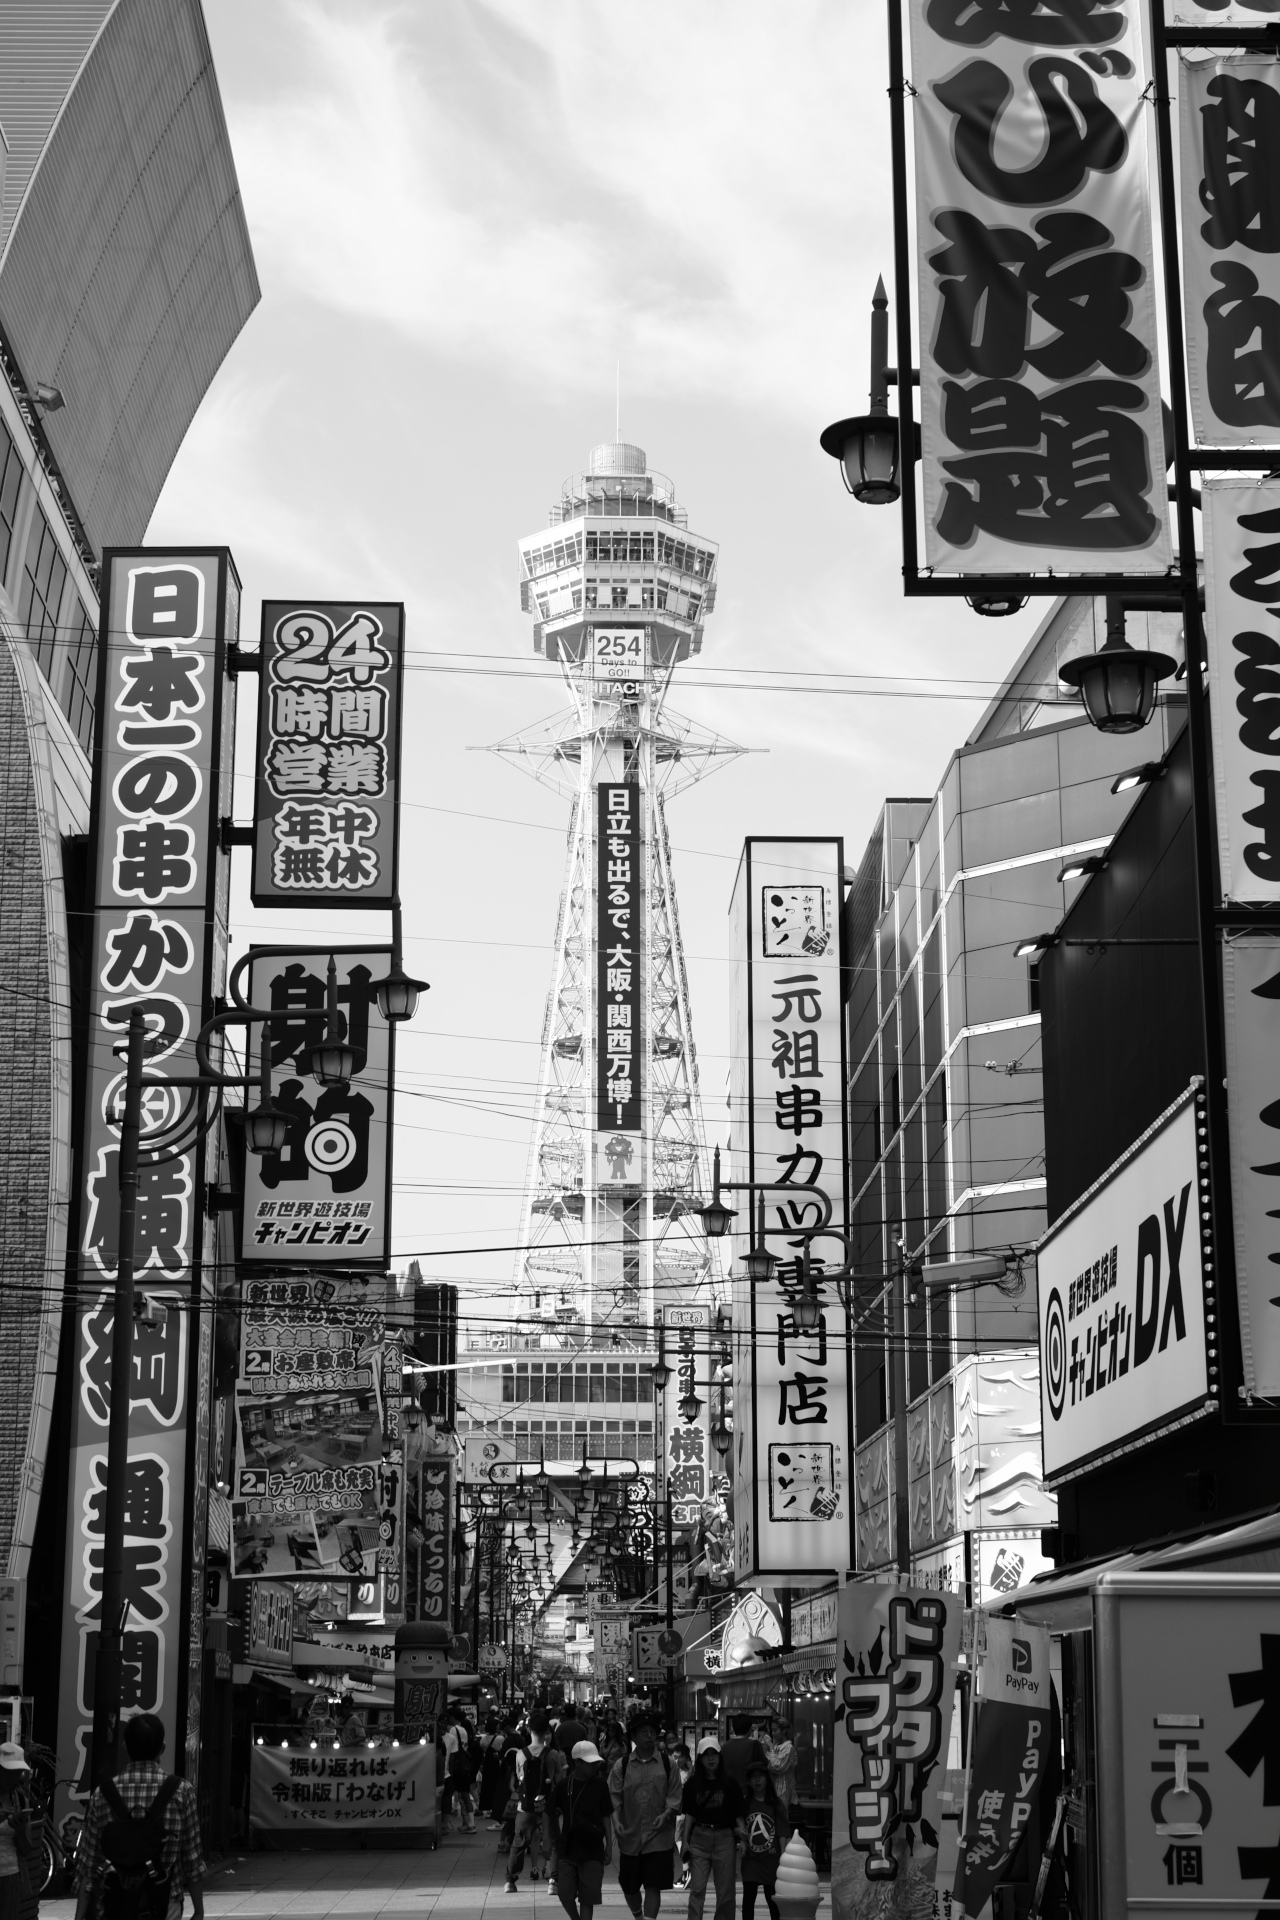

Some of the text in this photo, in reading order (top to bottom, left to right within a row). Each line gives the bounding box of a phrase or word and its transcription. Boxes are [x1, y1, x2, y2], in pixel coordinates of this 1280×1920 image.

[272, 611, 392, 686] 24
[597, 636, 641, 656] 254
[601, 657, 637, 668] Days to
[608, 669, 630, 678] GO!!
[591, 682, 652, 694] HITACHI
[271, 686, 388, 741] 時間
[266, 741, 387, 798] 営業
[272, 802, 379, 846] 年中
[272, 846, 380, 890] 無休
[258, 963, 378, 1193] 射的
[256, 1201, 371, 1218] 新世界遊技場
[253, 1222, 370, 1246] チャンピオン
[1068, 1244, 1117, 1323] 新世界遊技場
[1134, 1180, 1192, 1369] DX
[247, 1281, 310, 1304] 新世界
[1069, 1301, 1132, 1407] チャンピオン
[269, 1467, 375, 1495] テーブル席も充実
[1006, 1674, 1039, 1694] PayPay
[891, 1600, 942, 1818] ドクター
[290, 1757, 397, 1778] 振り返れば、
[271, 1780, 415, 1802] 令和版「わなげ」
